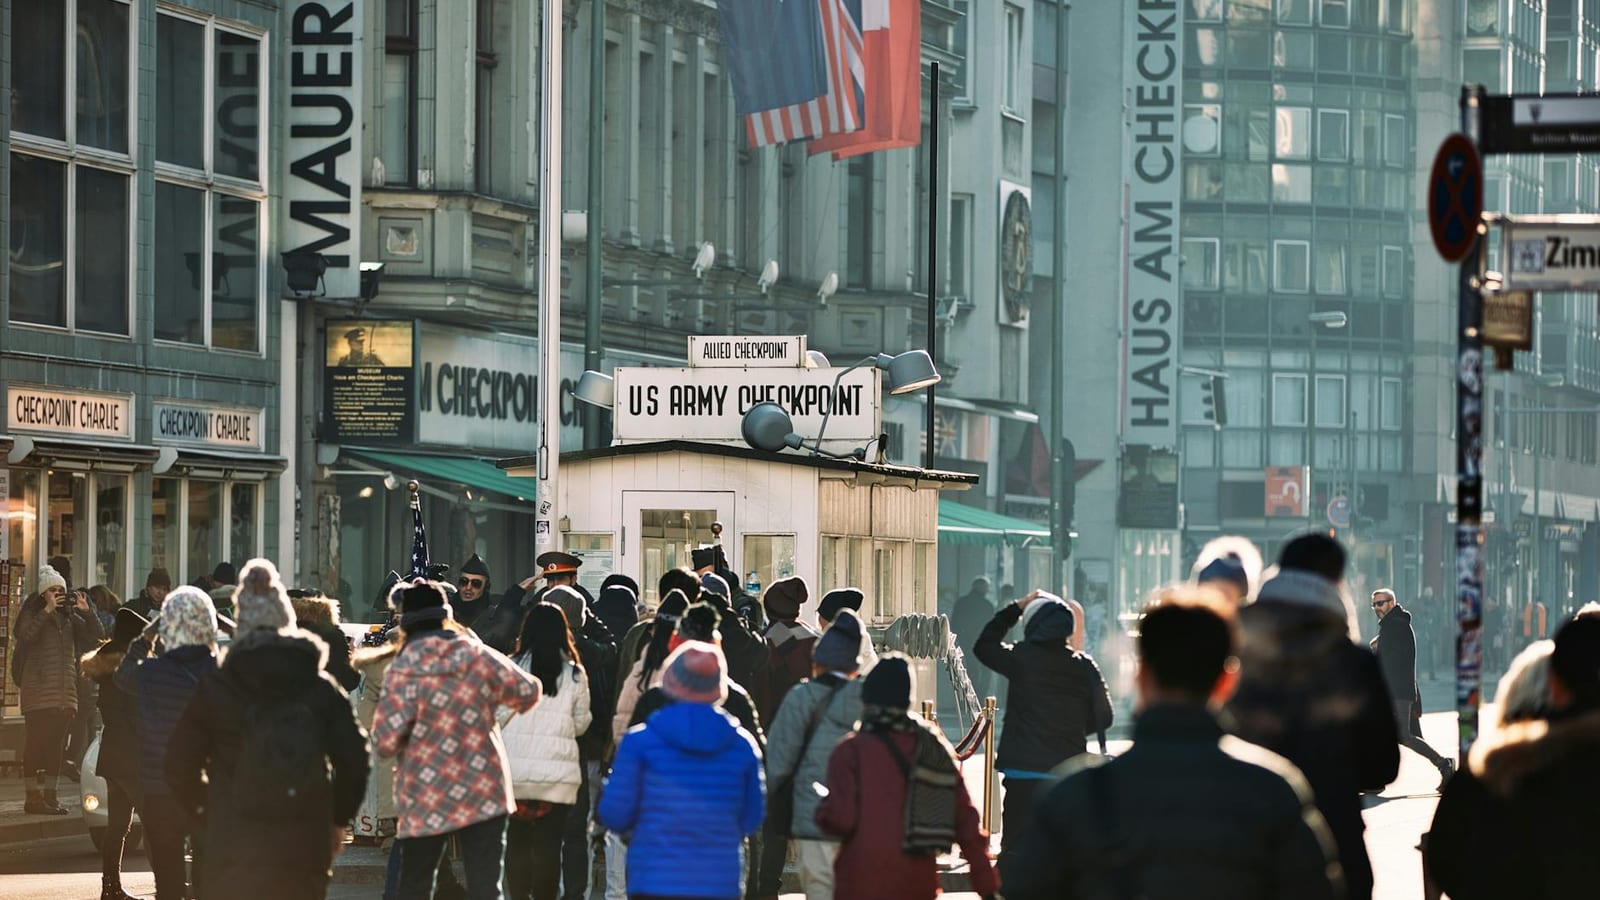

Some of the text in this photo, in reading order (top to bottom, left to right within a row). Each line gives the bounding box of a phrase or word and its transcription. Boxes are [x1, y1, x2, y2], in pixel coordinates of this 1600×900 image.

[290, 2, 353, 267] MAUER
[1134, 201, 1173, 282] AM
[1546, 236, 1600, 268] Zim
[703, 342, 788, 359] ALLIED CHECKPOINT
[1131, 298, 1172, 427] HAUS
[16, 394, 119, 431] CHECKPOINT CHARLIE
[670, 385, 728, 416] ARMY
[159, 408, 250, 442] CHECKPOINT CHARLIE
